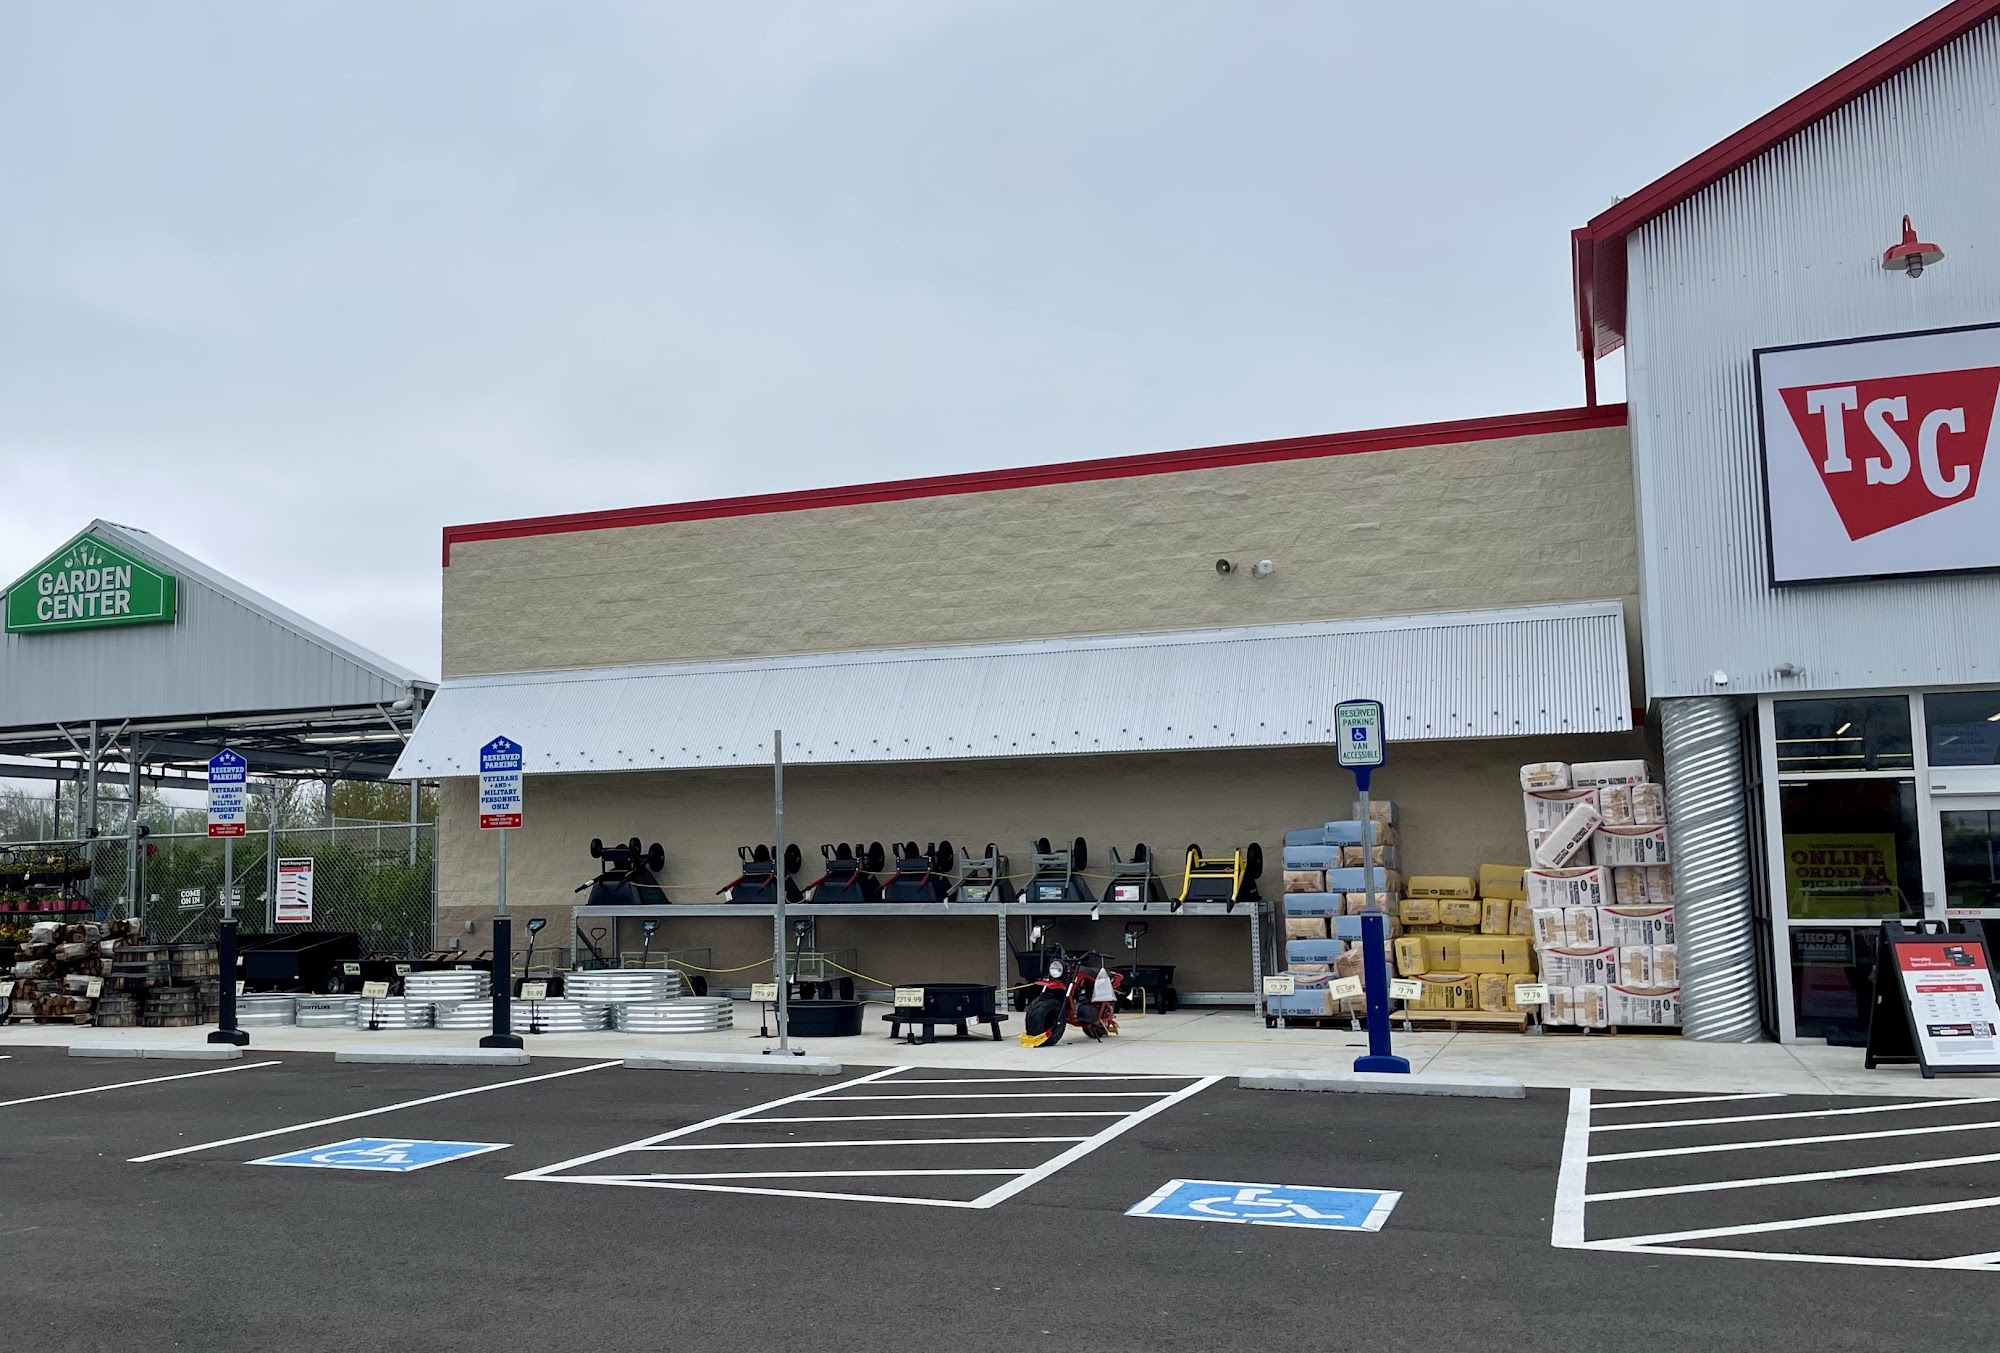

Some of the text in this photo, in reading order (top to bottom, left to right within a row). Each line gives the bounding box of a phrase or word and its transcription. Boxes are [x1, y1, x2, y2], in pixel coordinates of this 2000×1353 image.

[1806, 386, 1970, 498] TSC
[38, 565, 132, 596] GARDEN
[37, 590, 130, 620] CENTER
[1340, 709, 1375, 717] RESERVED
[1343, 718, 1374, 726] PARKING
[1343, 751, 1378, 759] ACCESSIBLE
[485, 761, 517, 769] PARKING
[1791, 850, 1885, 865] ONLINE
[1796, 867, 1860, 878] ORDER
[1796, 933, 1835, 943] SHOP
[1797, 943, 1847, 951] MANAGE
